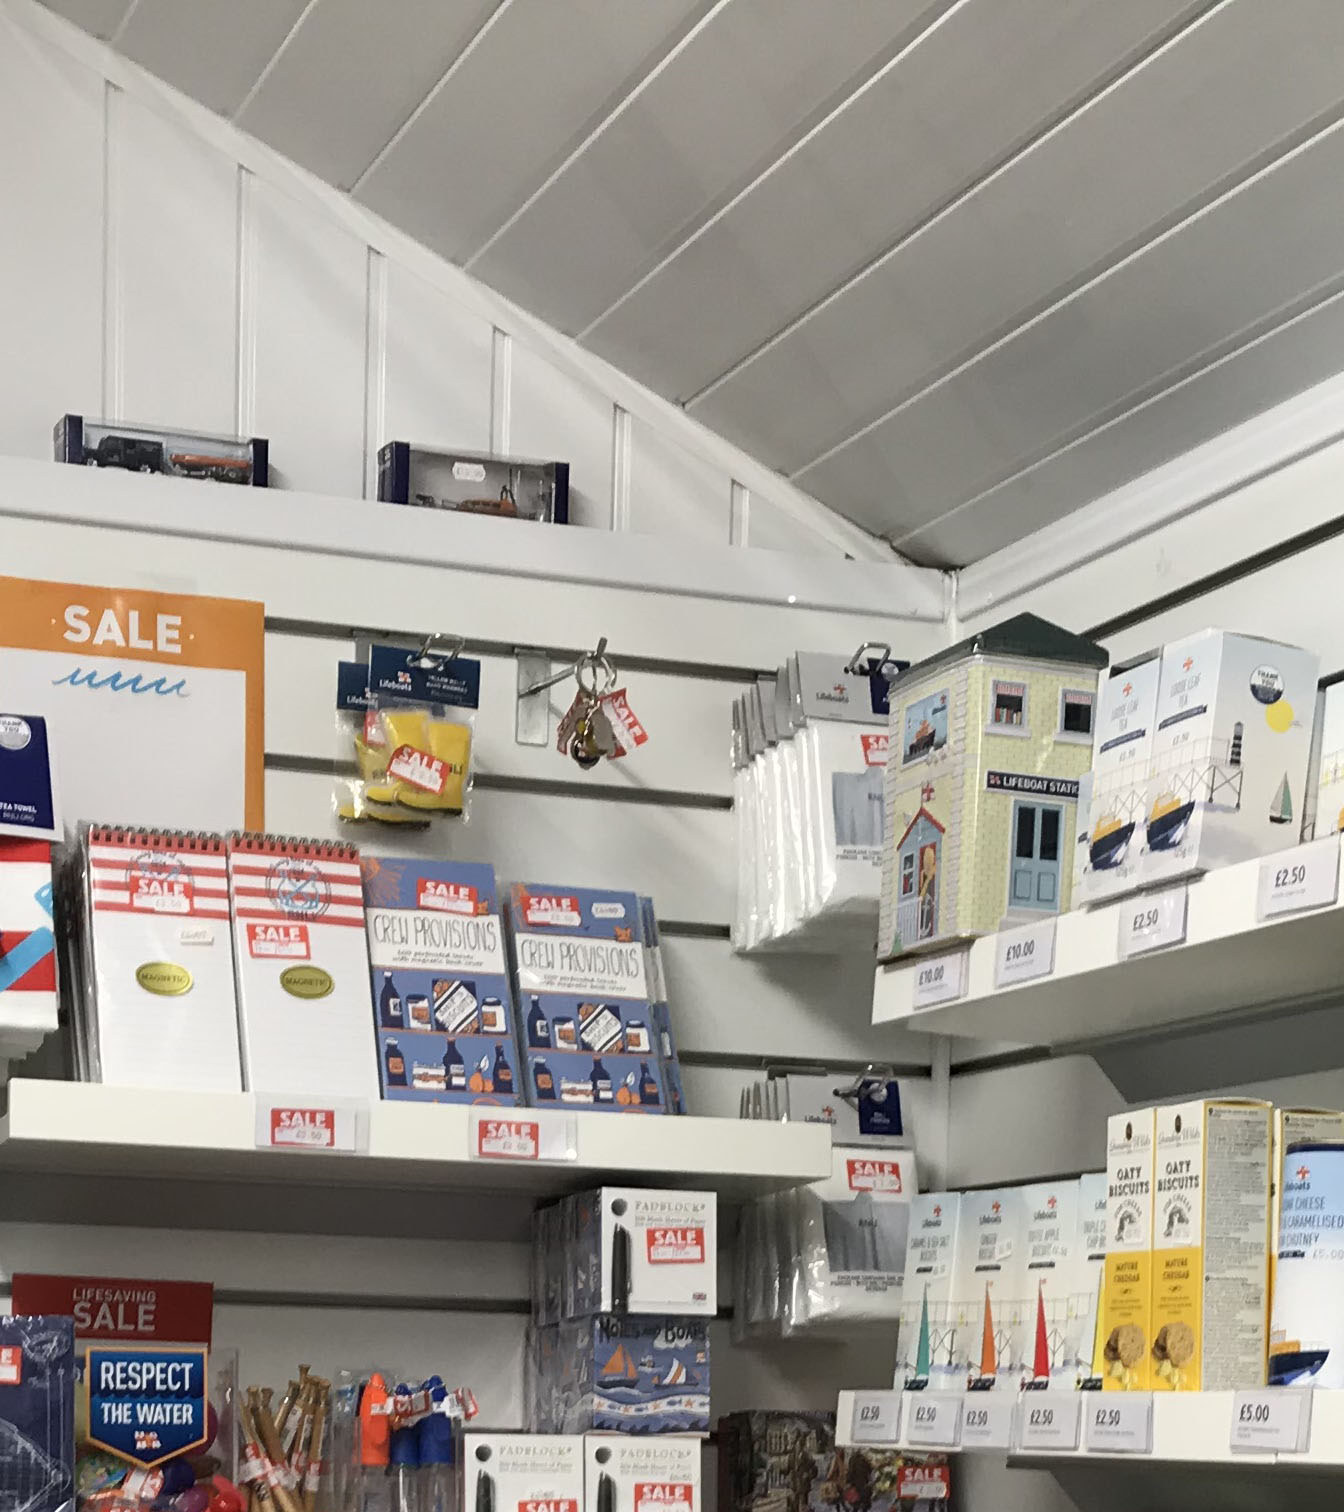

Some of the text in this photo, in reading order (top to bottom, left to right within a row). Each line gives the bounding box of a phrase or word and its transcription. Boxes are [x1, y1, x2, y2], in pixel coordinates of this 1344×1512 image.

[63, 605, 183, 655] SALE
[398, 748, 446, 775] SALE
[1003, 775, 1047, 790] LIFEBOAT
[1275, 866, 1306, 887] £2.50
[137, 880, 184, 897] SALE
[424, 882, 470, 900] SALE
[530, 897, 571, 913] SALE
[1133, 909, 1159, 929] £2.50
[254, 927, 301, 943] SALE
[373, 915, 496, 953] CREW PROVISIONS
[521, 939, 638, 979] CREW PROVISIONS
[1006, 940, 1035, 961] £10.00
[919, 966, 944, 986] £10.00
[280, 1110, 326, 1128] SALE
[486, 1123, 531, 1139] SALE
[854, 1161, 892, 1177] SALE
[1166, 1160, 1189, 1175] OATY
[1157, 1175, 1199, 1191] BISCUITS
[654, 1229, 696, 1246] SALE
[73, 1289, 156, 1303] LIFESAVING
[73, 1301, 157, 1332] SALE
[100, 1361, 194, 1391] RESPECT
[101, 1403, 193, 1425] THE WATER
[967, 1411, 987, 1426] £2.50
[1030, 1410, 1052, 1424] £2.50
[1096, 1410, 1120, 1425] £2.50
[1239, 1404, 1269, 1422] £5.00
[906, 1467, 942, 1483] SALE
[641, 1485, 685, 1501] SALE
